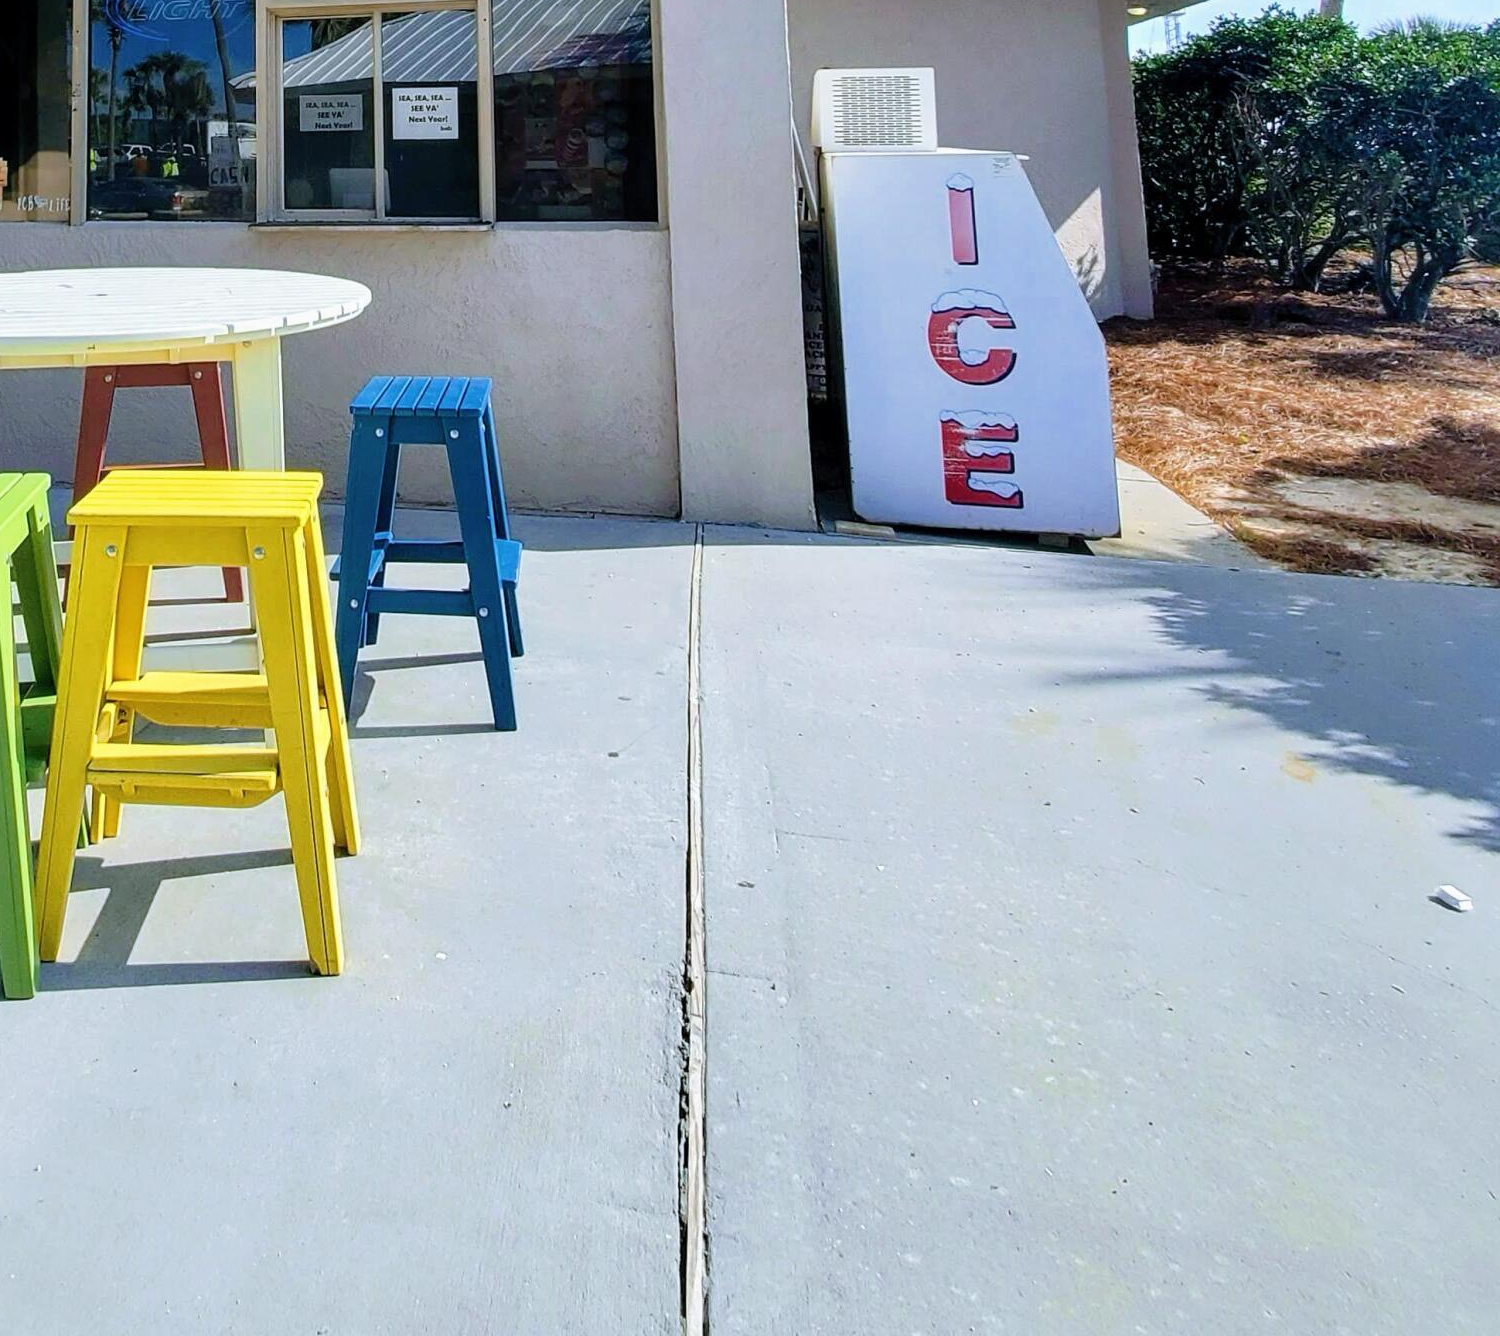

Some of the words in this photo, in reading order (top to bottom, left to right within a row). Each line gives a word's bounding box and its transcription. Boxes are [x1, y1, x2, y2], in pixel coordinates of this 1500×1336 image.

[317, 111, 330, 119] SEE
[428, 115, 448, 123] Year!
[333, 121, 353, 129] Year!
[927, 172, 1024, 509] ICE
